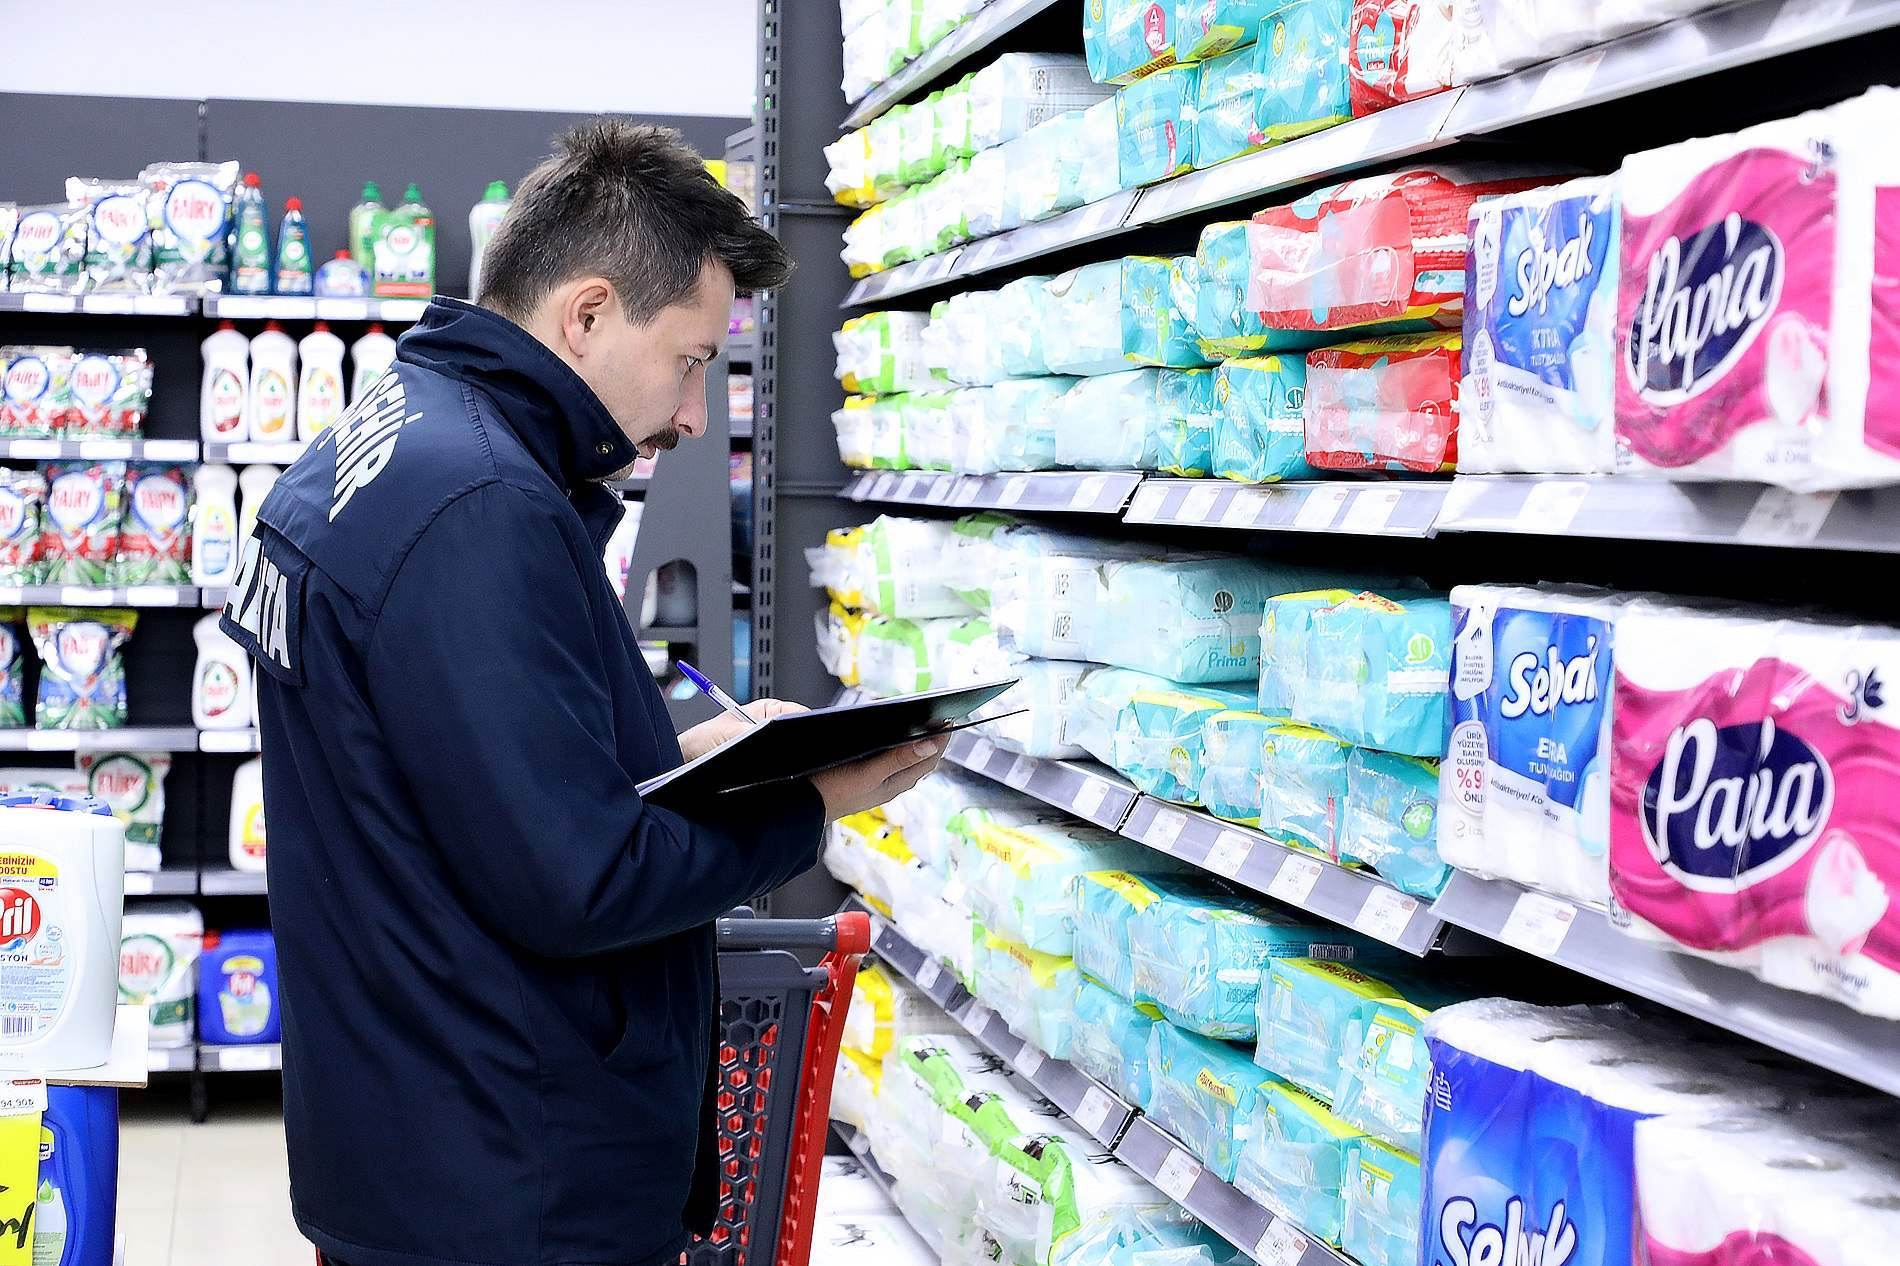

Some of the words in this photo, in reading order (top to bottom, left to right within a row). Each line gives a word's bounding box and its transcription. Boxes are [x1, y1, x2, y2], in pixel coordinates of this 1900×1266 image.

[1149, 8, 1160, 26] 4
[1208, 651, 1247, 668] Prima
[1132, 1060, 1140, 1076] 5
